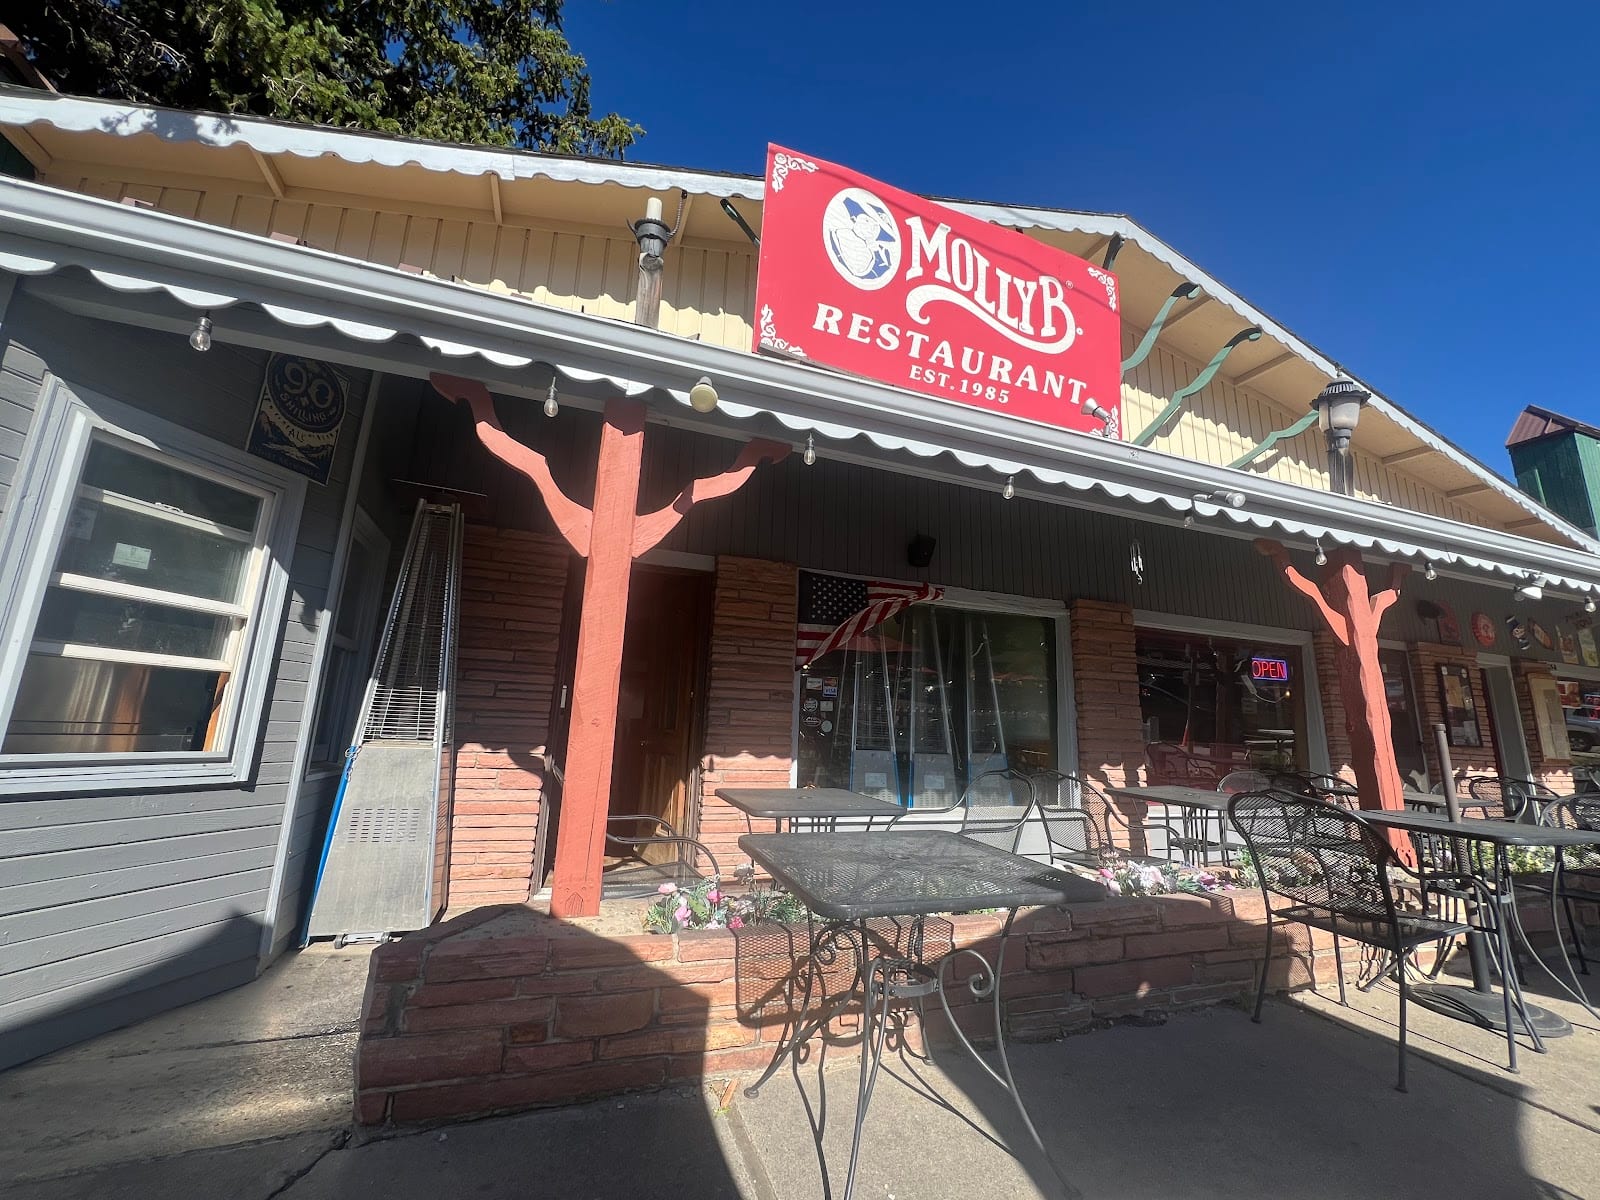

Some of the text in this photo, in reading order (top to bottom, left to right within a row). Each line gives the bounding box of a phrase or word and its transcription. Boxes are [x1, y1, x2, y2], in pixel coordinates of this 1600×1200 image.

[812, 303, 1088, 404] RESTAURANT
[284, 361, 335, 409] 90
[280, 392, 328, 424] SHILLING
[1252, 660, 1285, 678] OPEN
